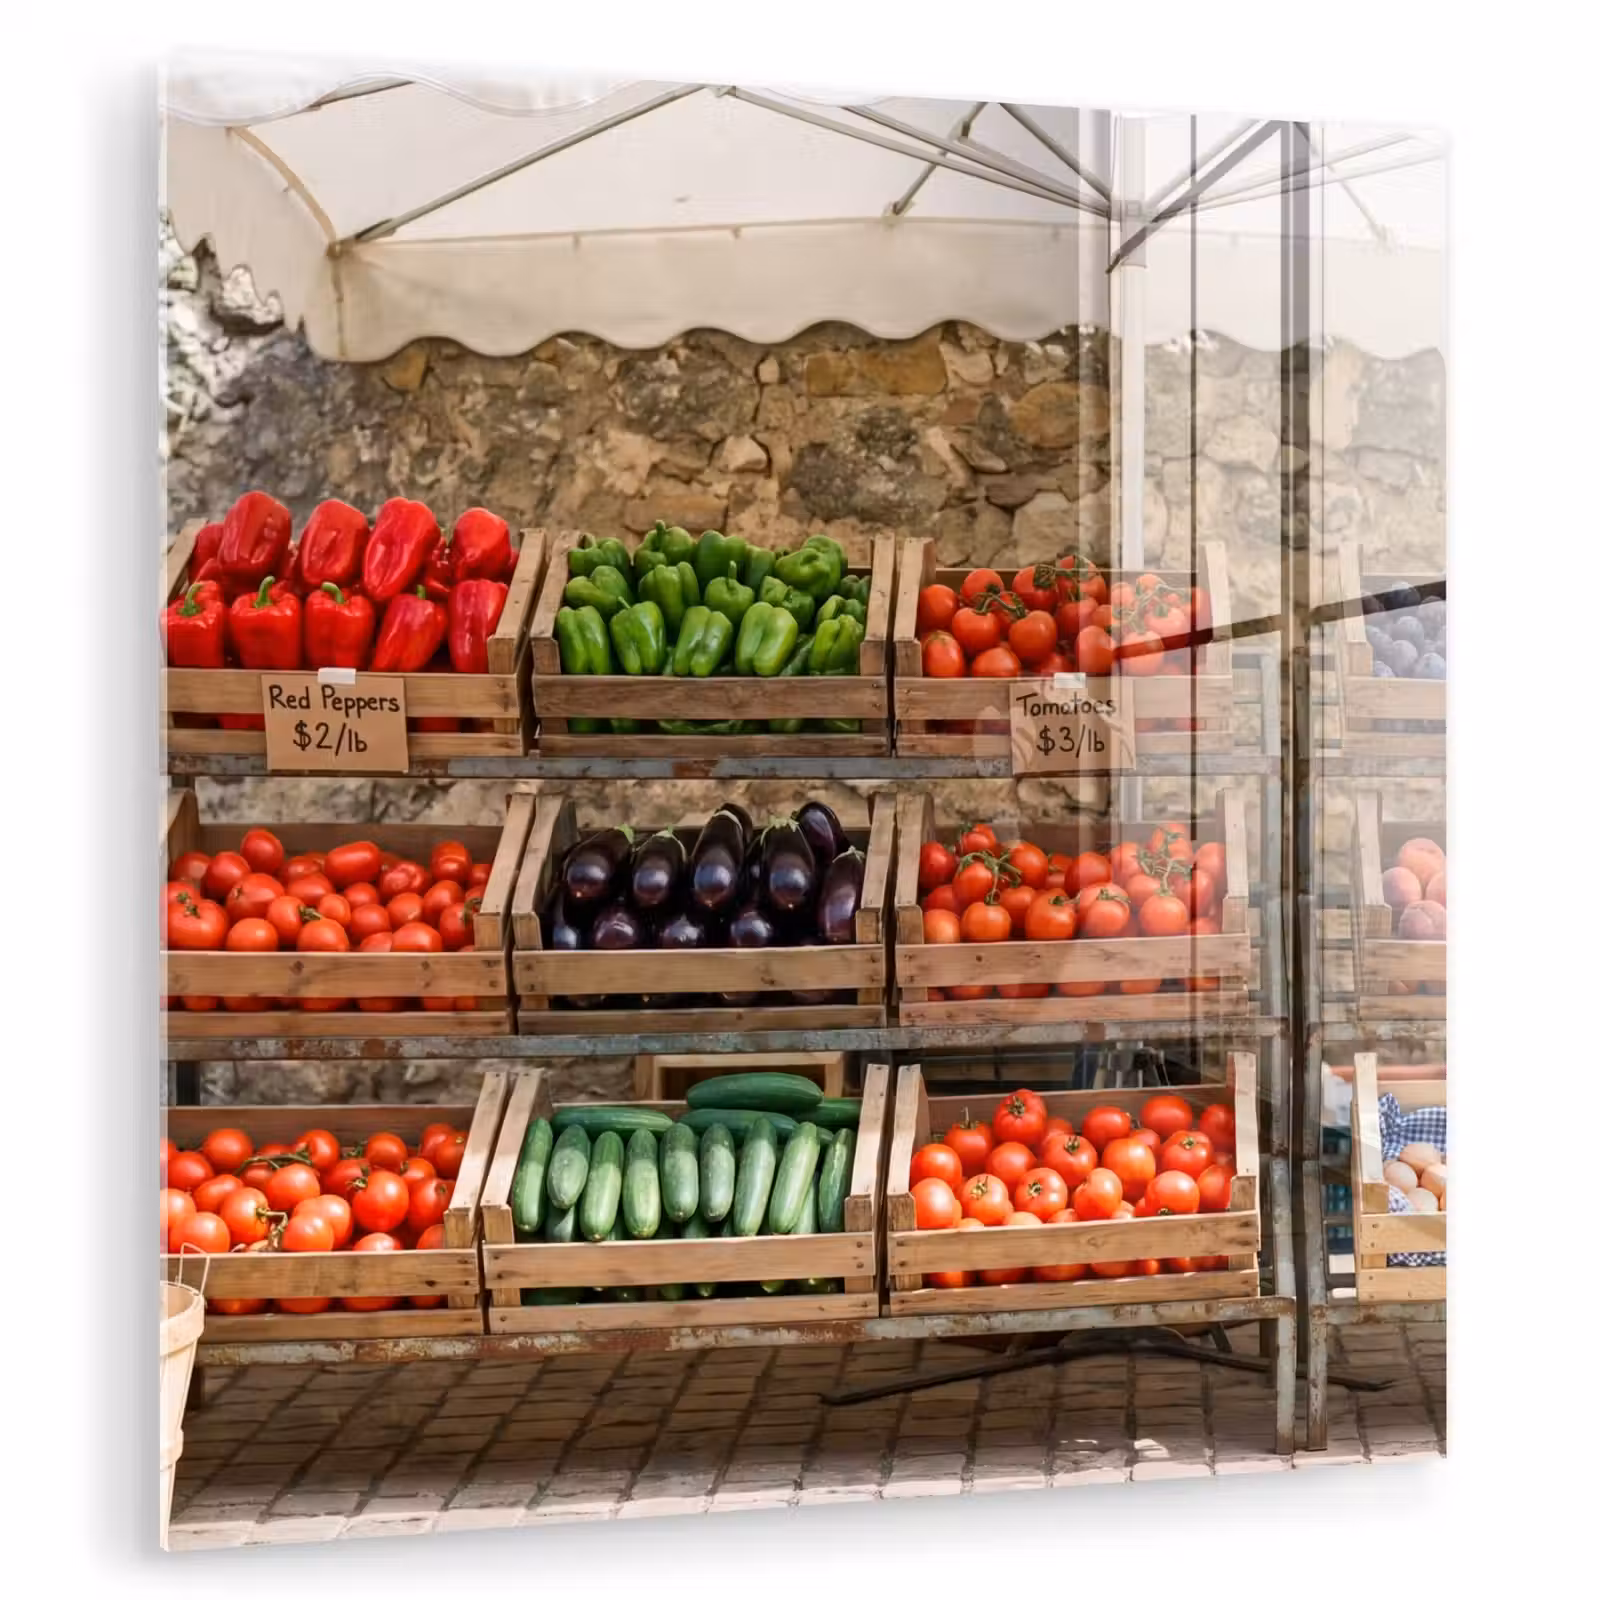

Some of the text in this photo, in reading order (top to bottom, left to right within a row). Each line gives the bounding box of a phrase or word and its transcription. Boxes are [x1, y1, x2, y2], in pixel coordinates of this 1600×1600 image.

[268, 684, 400, 718] Red Peppers
[292, 720, 368, 756] $2/lb
[1036, 724, 1105, 758] $3/lb
